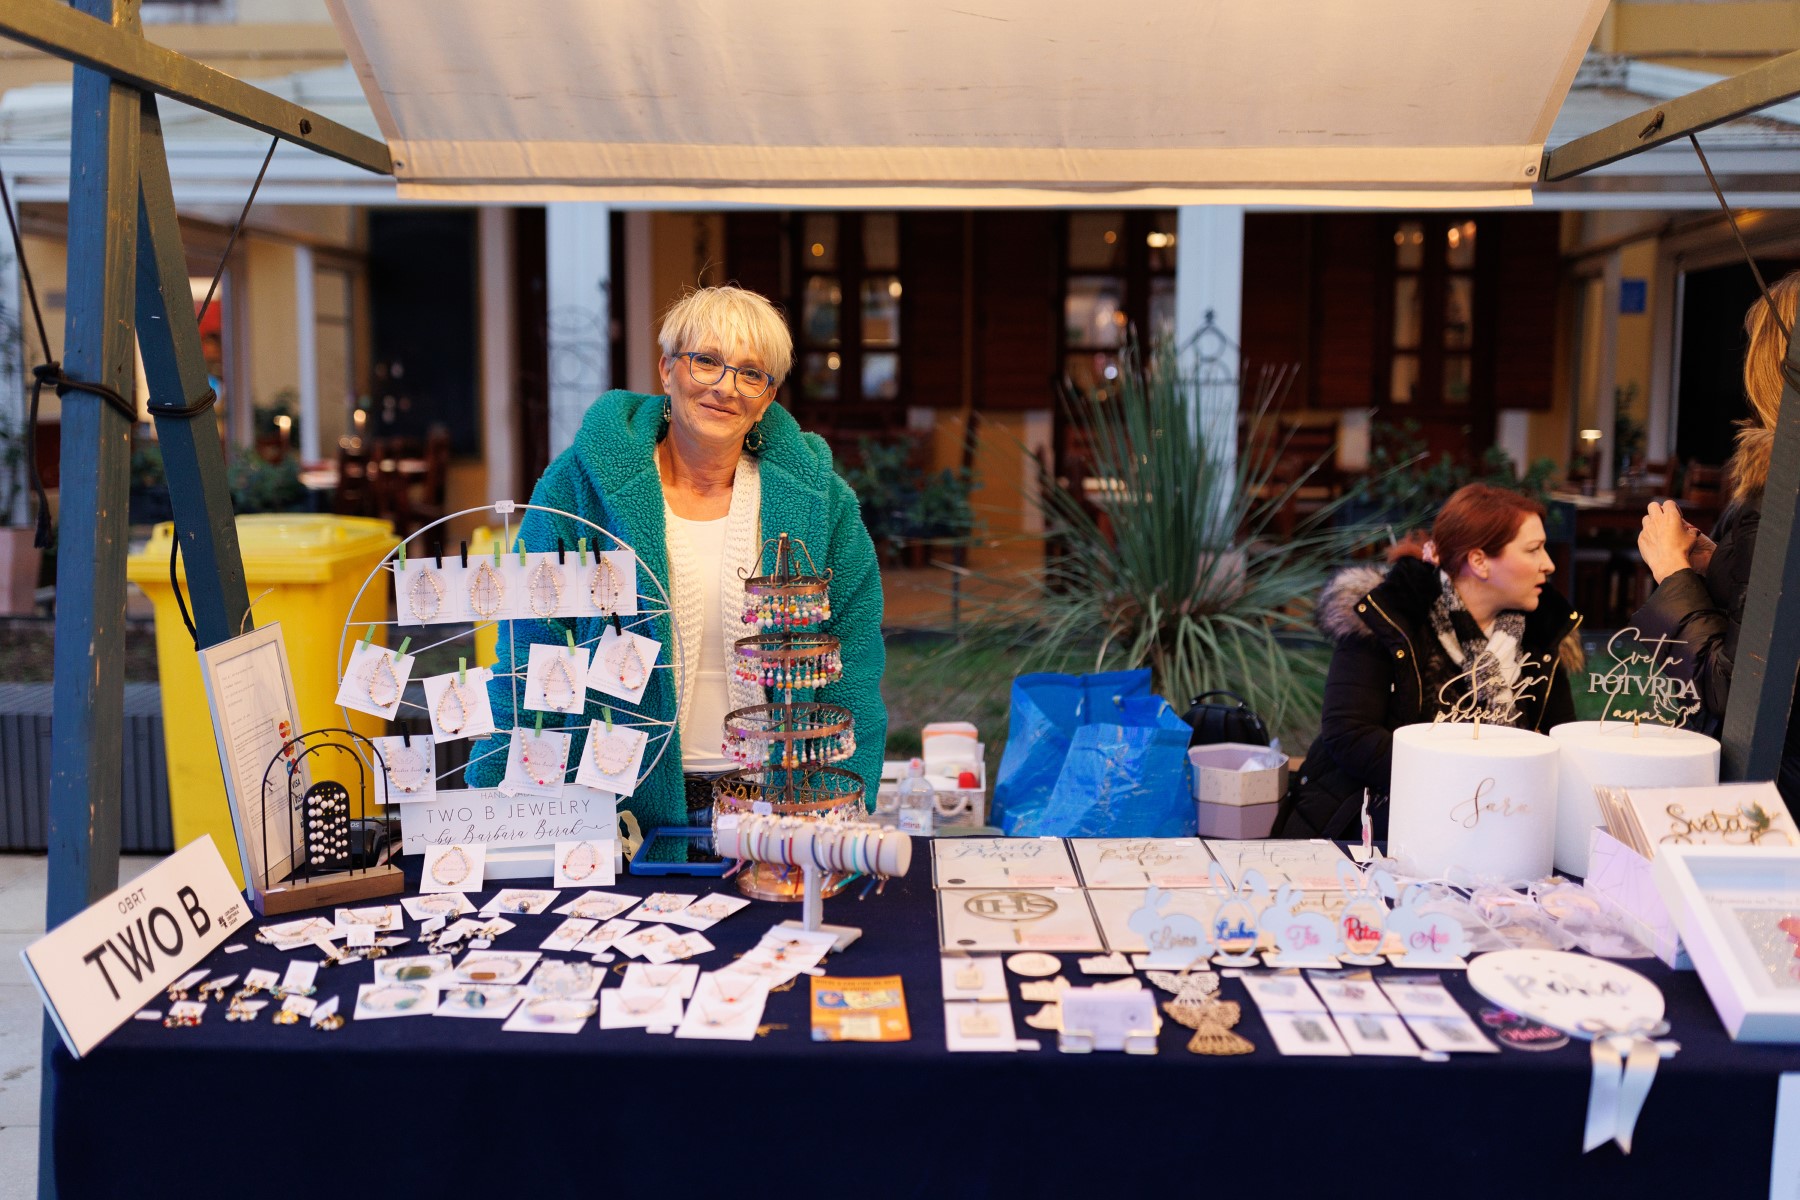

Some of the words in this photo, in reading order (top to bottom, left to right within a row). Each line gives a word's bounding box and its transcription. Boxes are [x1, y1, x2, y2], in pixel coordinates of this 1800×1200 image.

[1604, 626, 1689, 684] Sveta
[1587, 672, 1701, 700] POTVRDA
[426, 807, 473, 824] TWO
[485, 805, 496, 820] B
[508, 799, 591, 819] JEWELRY
[462, 824, 527, 845] Barbara
[118, 887, 148, 915] OBRT
[1216, 919, 1259, 941] Luka
[1344, 915, 1382, 942] Rita
[83, 906, 184, 1001] TWO
[176, 885, 212, 938] B
